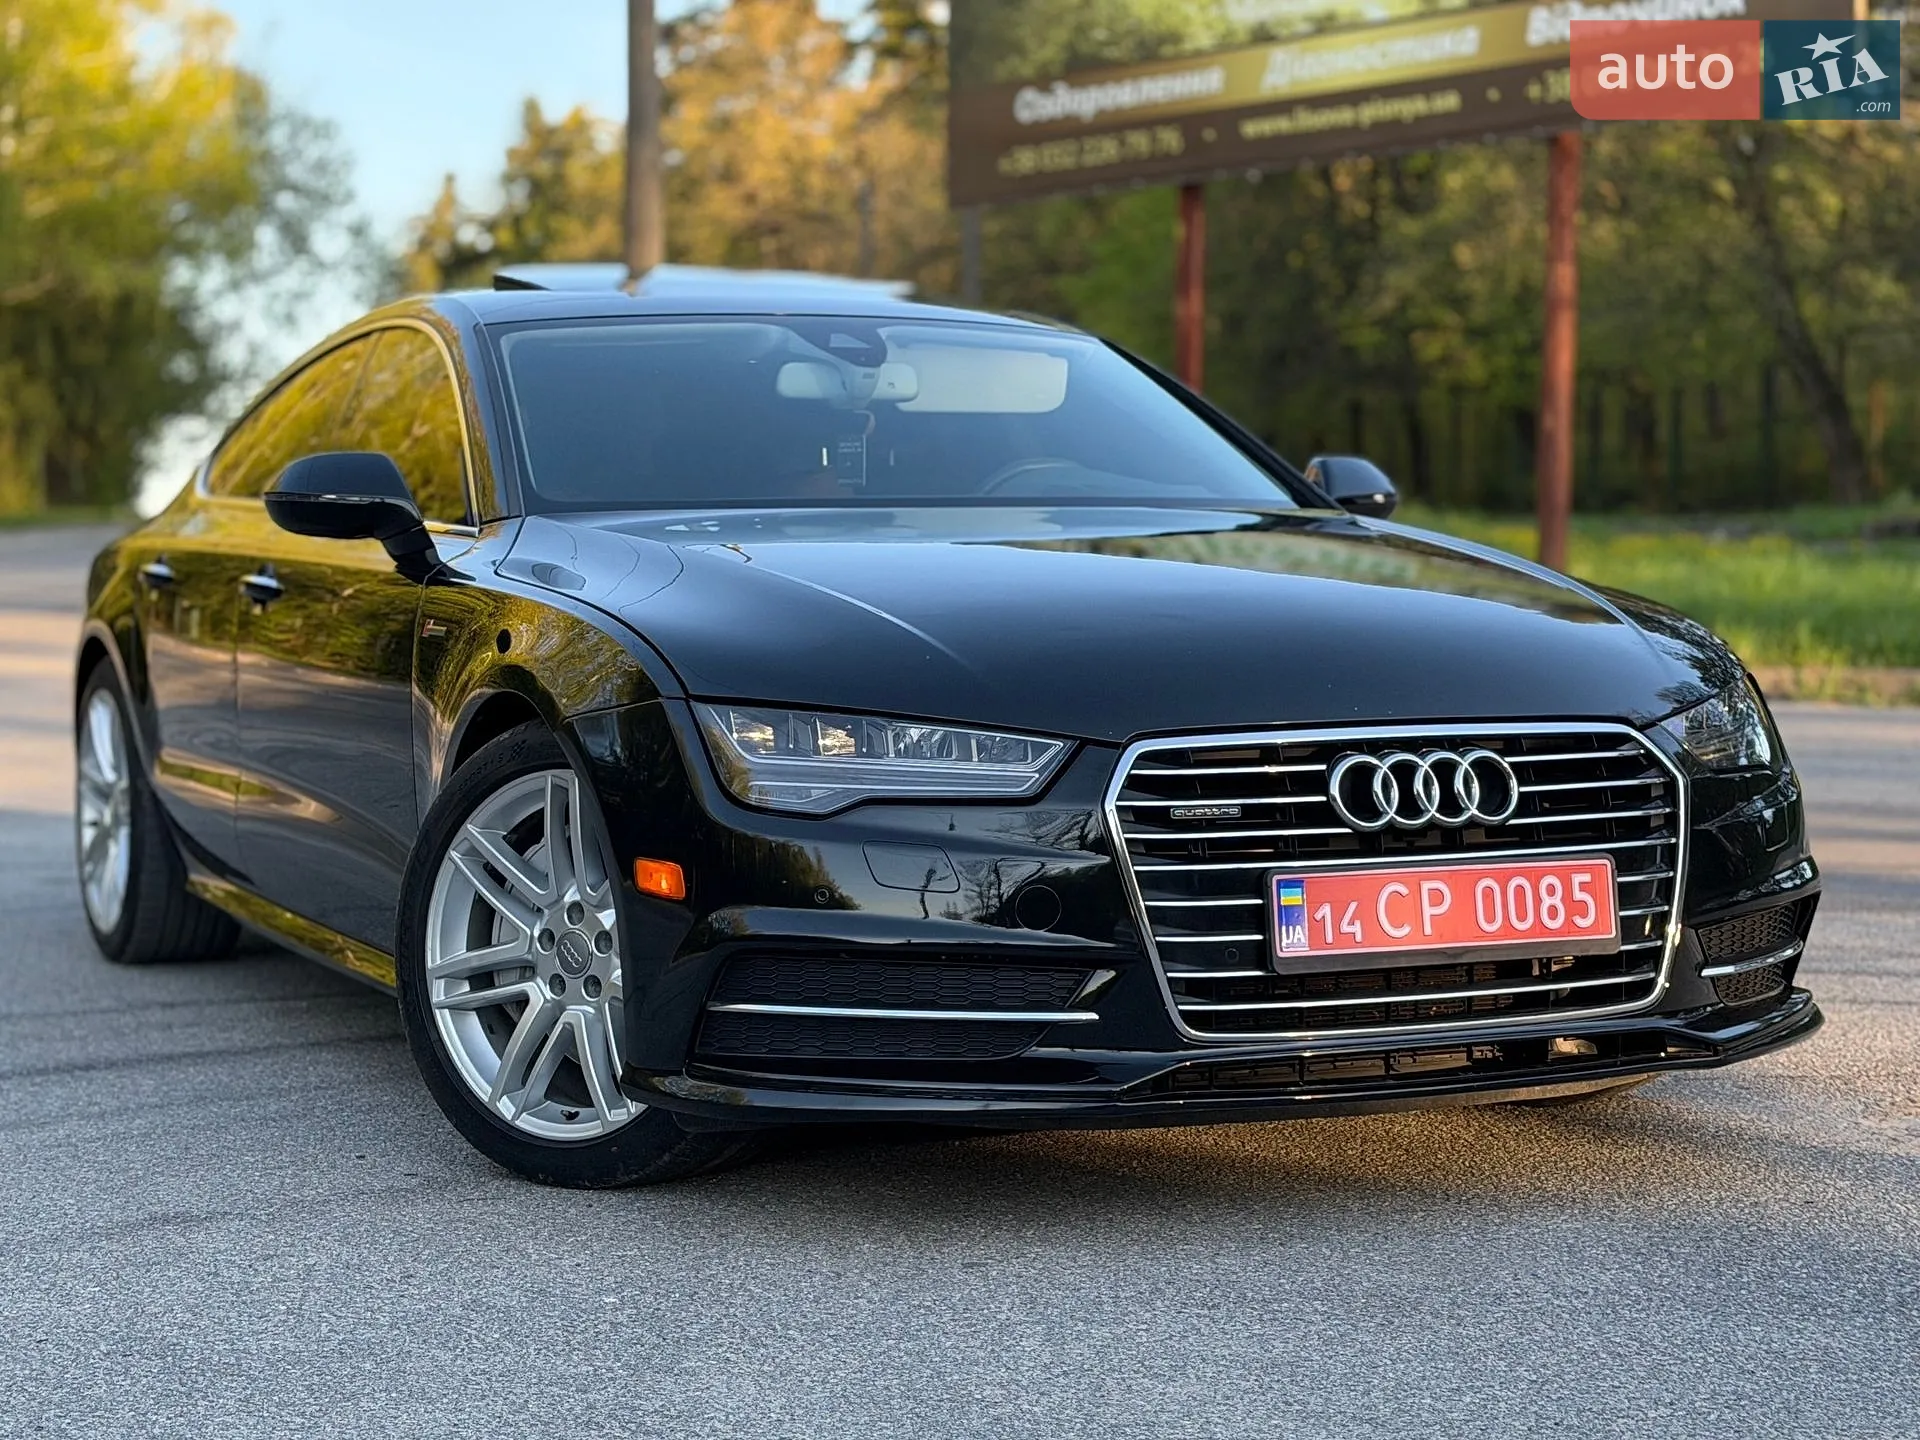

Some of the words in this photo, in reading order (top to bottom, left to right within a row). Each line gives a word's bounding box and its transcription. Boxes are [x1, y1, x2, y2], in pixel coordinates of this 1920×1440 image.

[1173, 807, 1239, 818] quattro
[1312, 901, 1363, 945] 14
[1376, 880, 1452, 939] CP
[1474, 872, 1597, 934] 0085
[1281, 924, 1307, 947] UA
